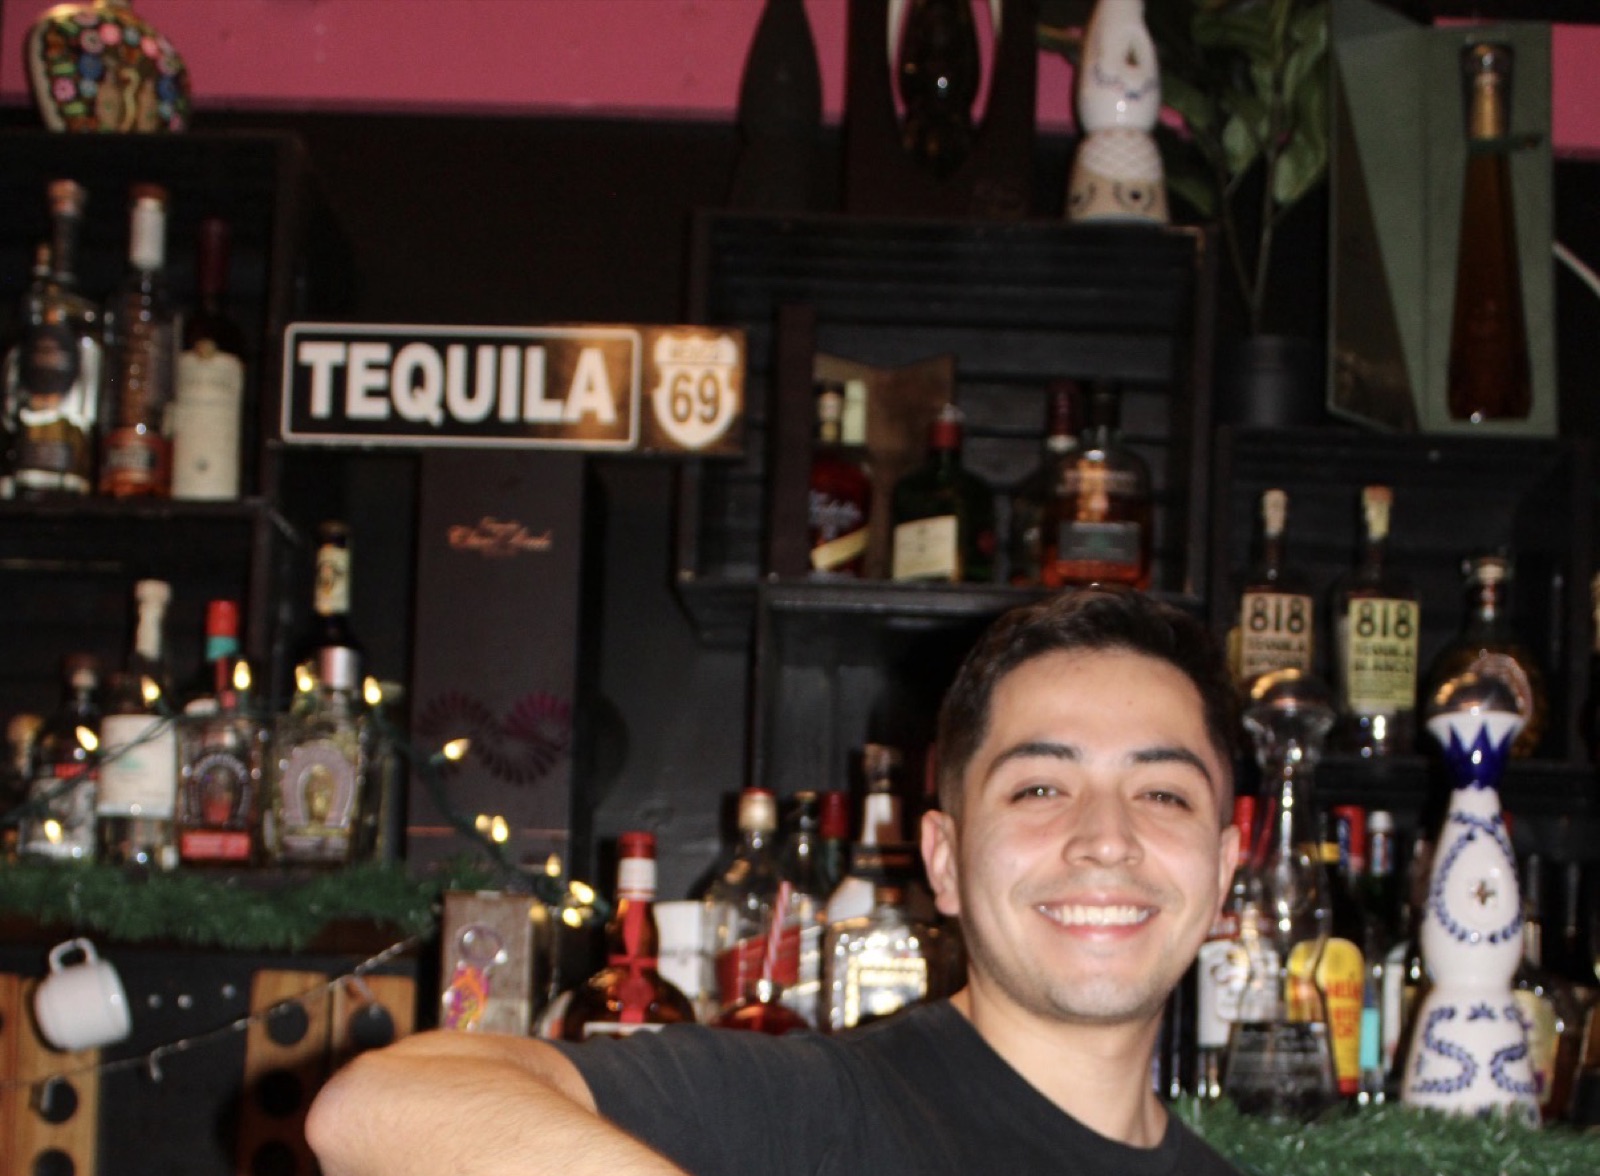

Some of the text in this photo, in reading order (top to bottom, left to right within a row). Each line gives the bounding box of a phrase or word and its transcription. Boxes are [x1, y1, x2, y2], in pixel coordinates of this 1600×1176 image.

[299, 342, 617, 425] TEQUILA
[671, 369, 722, 425] 69
[1251, 596, 1305, 634] 818
[1357, 602, 1411, 638] 818
